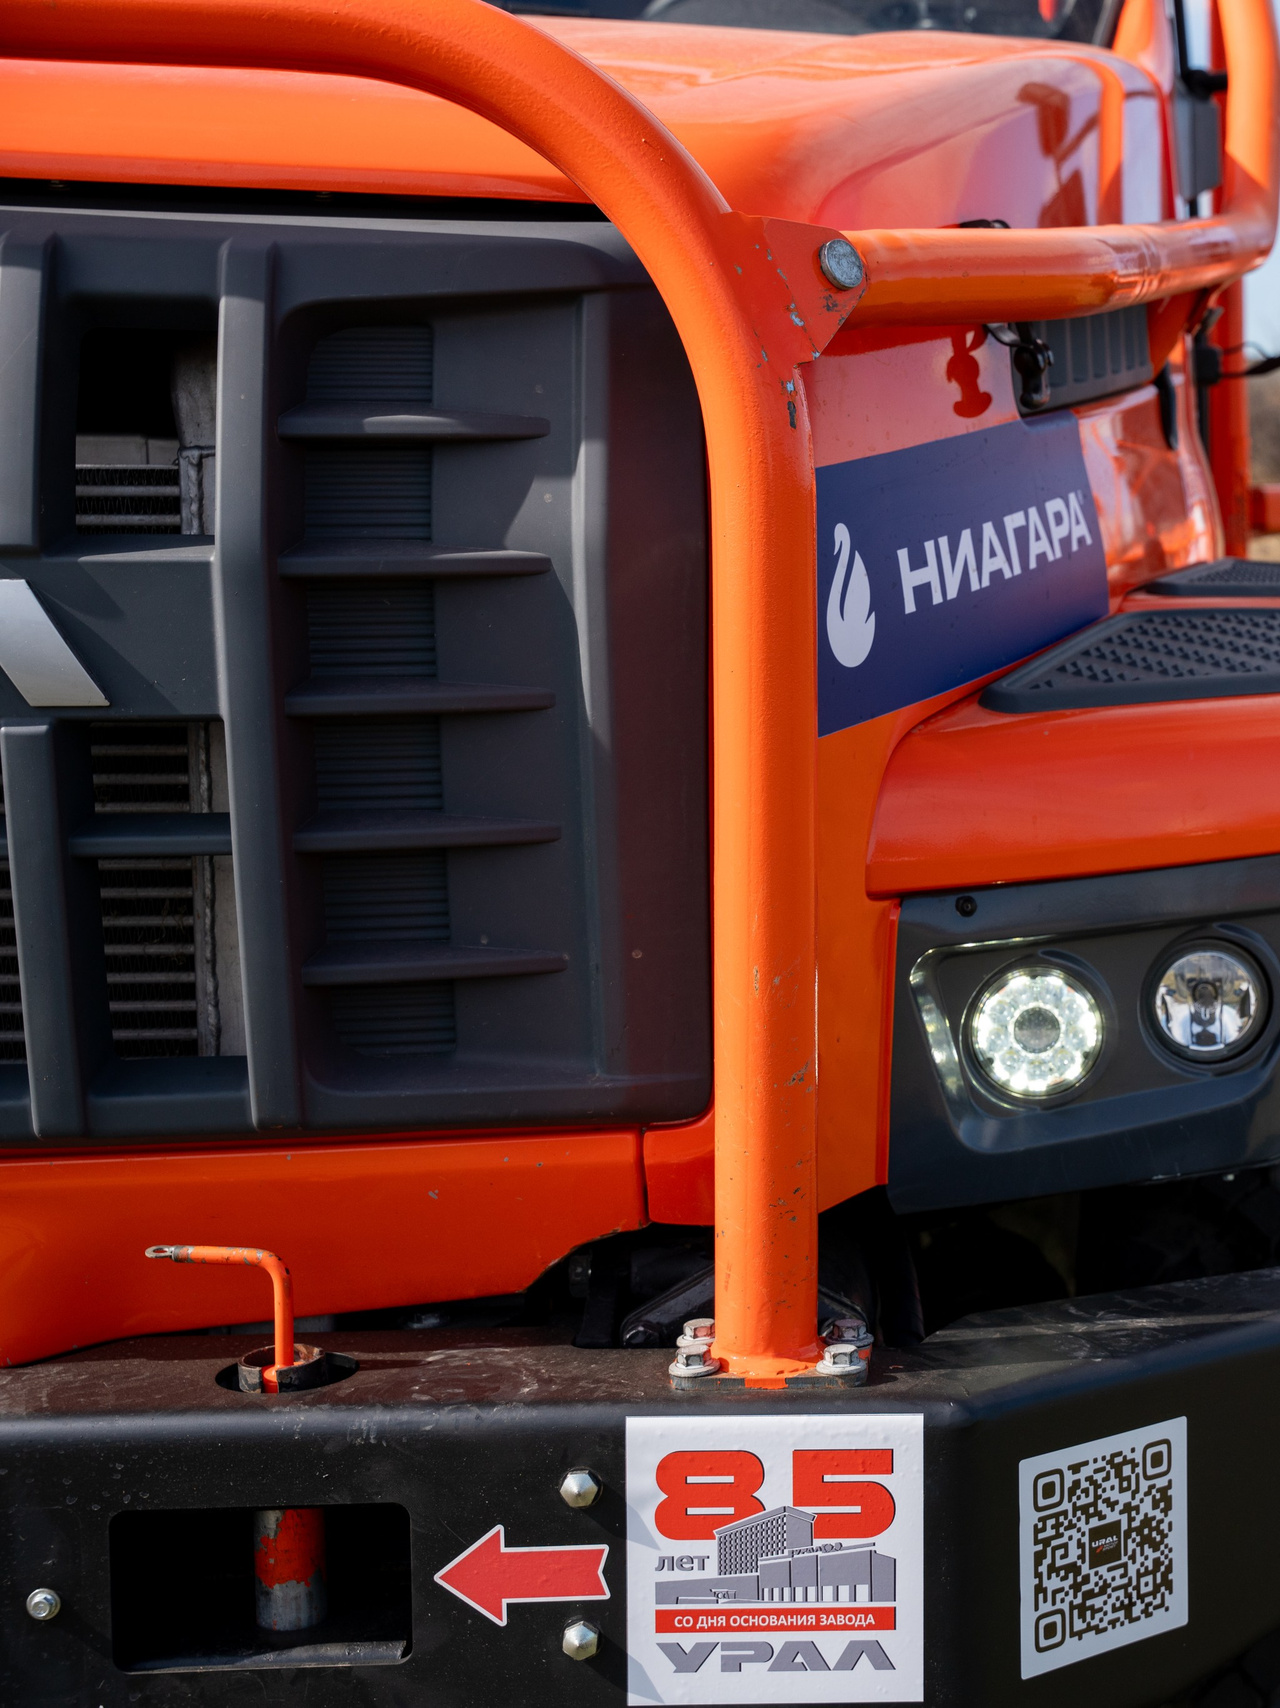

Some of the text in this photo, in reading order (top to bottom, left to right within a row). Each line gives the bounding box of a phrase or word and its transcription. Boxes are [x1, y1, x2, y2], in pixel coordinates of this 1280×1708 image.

[897, 491, 1093, 615] НИАГАРА
[654, 1448, 896, 1541] 85
[655, 1554, 710, 1572] лет
[674, 1613, 876, 1629] СО ДНЯ ОСНОВАНИЯ ЗАВОДА
[656, 1639, 896, 1673] УРАЛ
